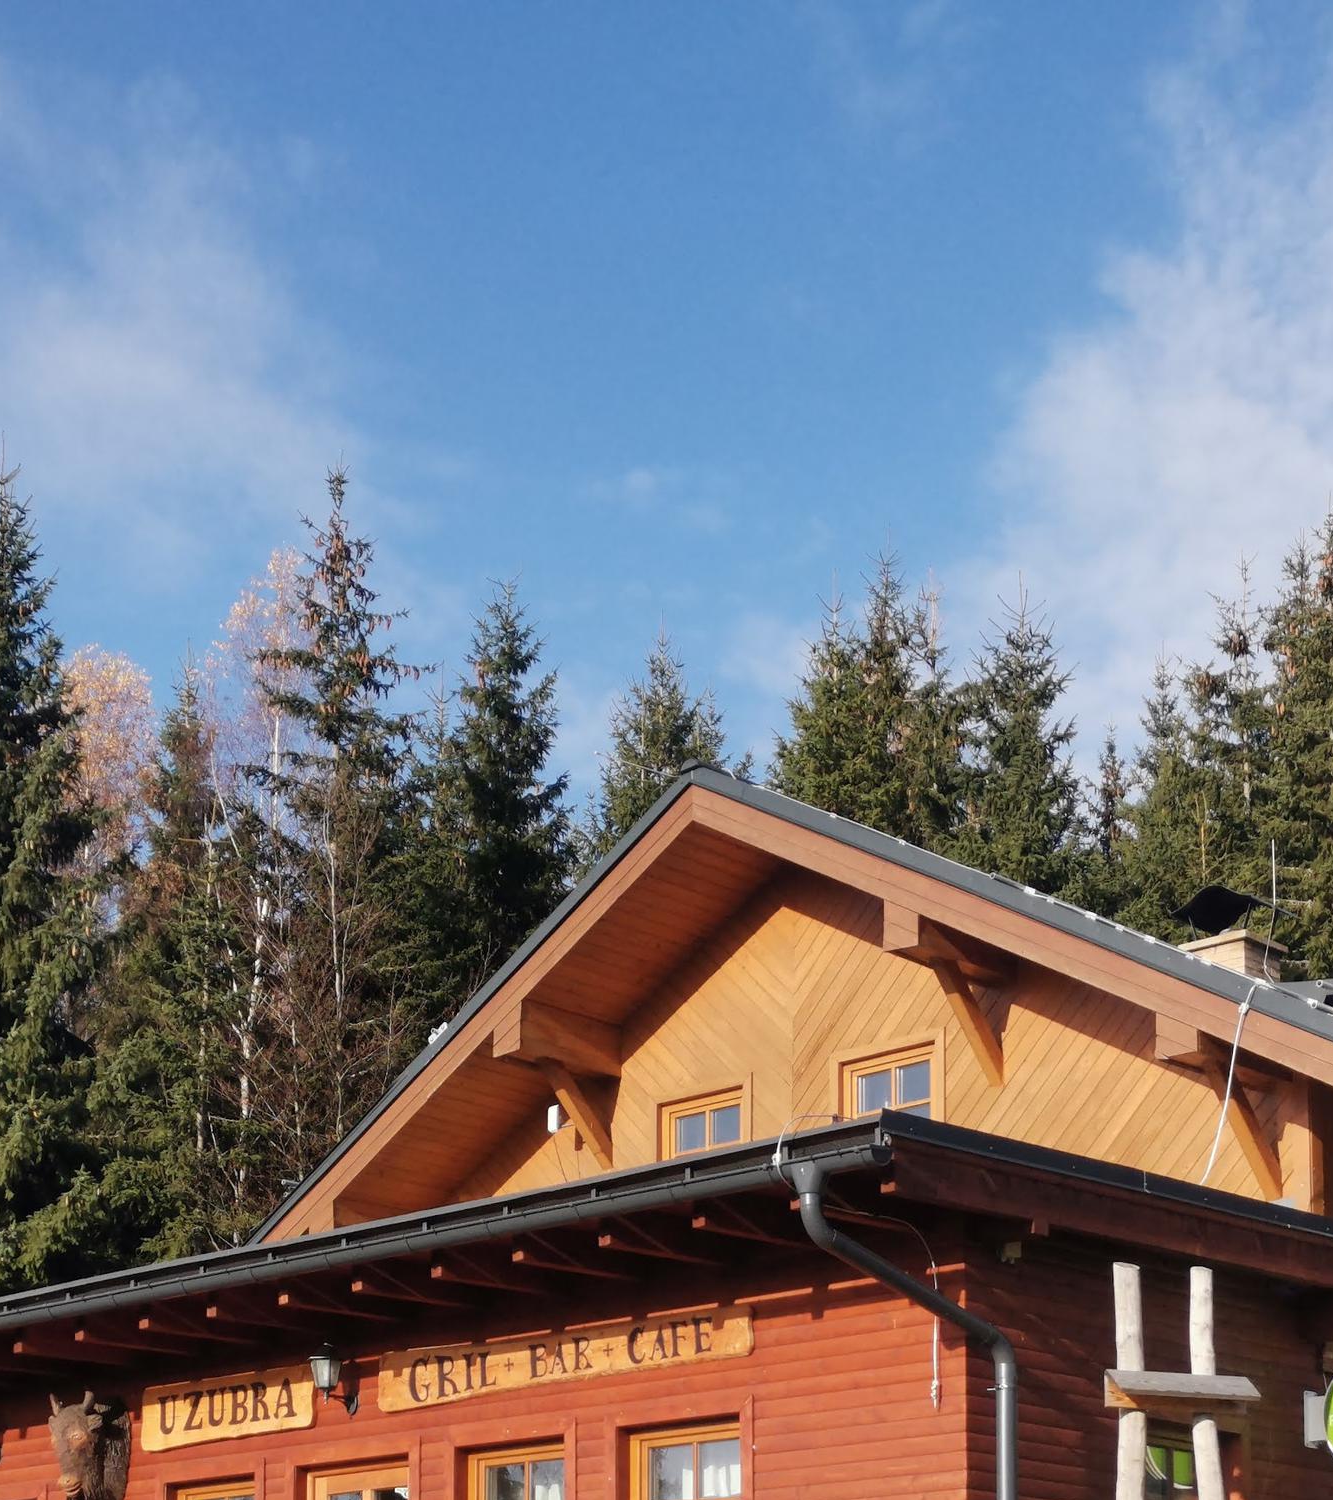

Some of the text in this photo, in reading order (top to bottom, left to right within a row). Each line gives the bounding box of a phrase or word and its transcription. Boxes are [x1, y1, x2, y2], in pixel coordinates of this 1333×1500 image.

[408, 1351, 497, 1402] GRIL
[528, 1336, 593, 1380] BAR
[627, 1316, 713, 1364] CAFE
